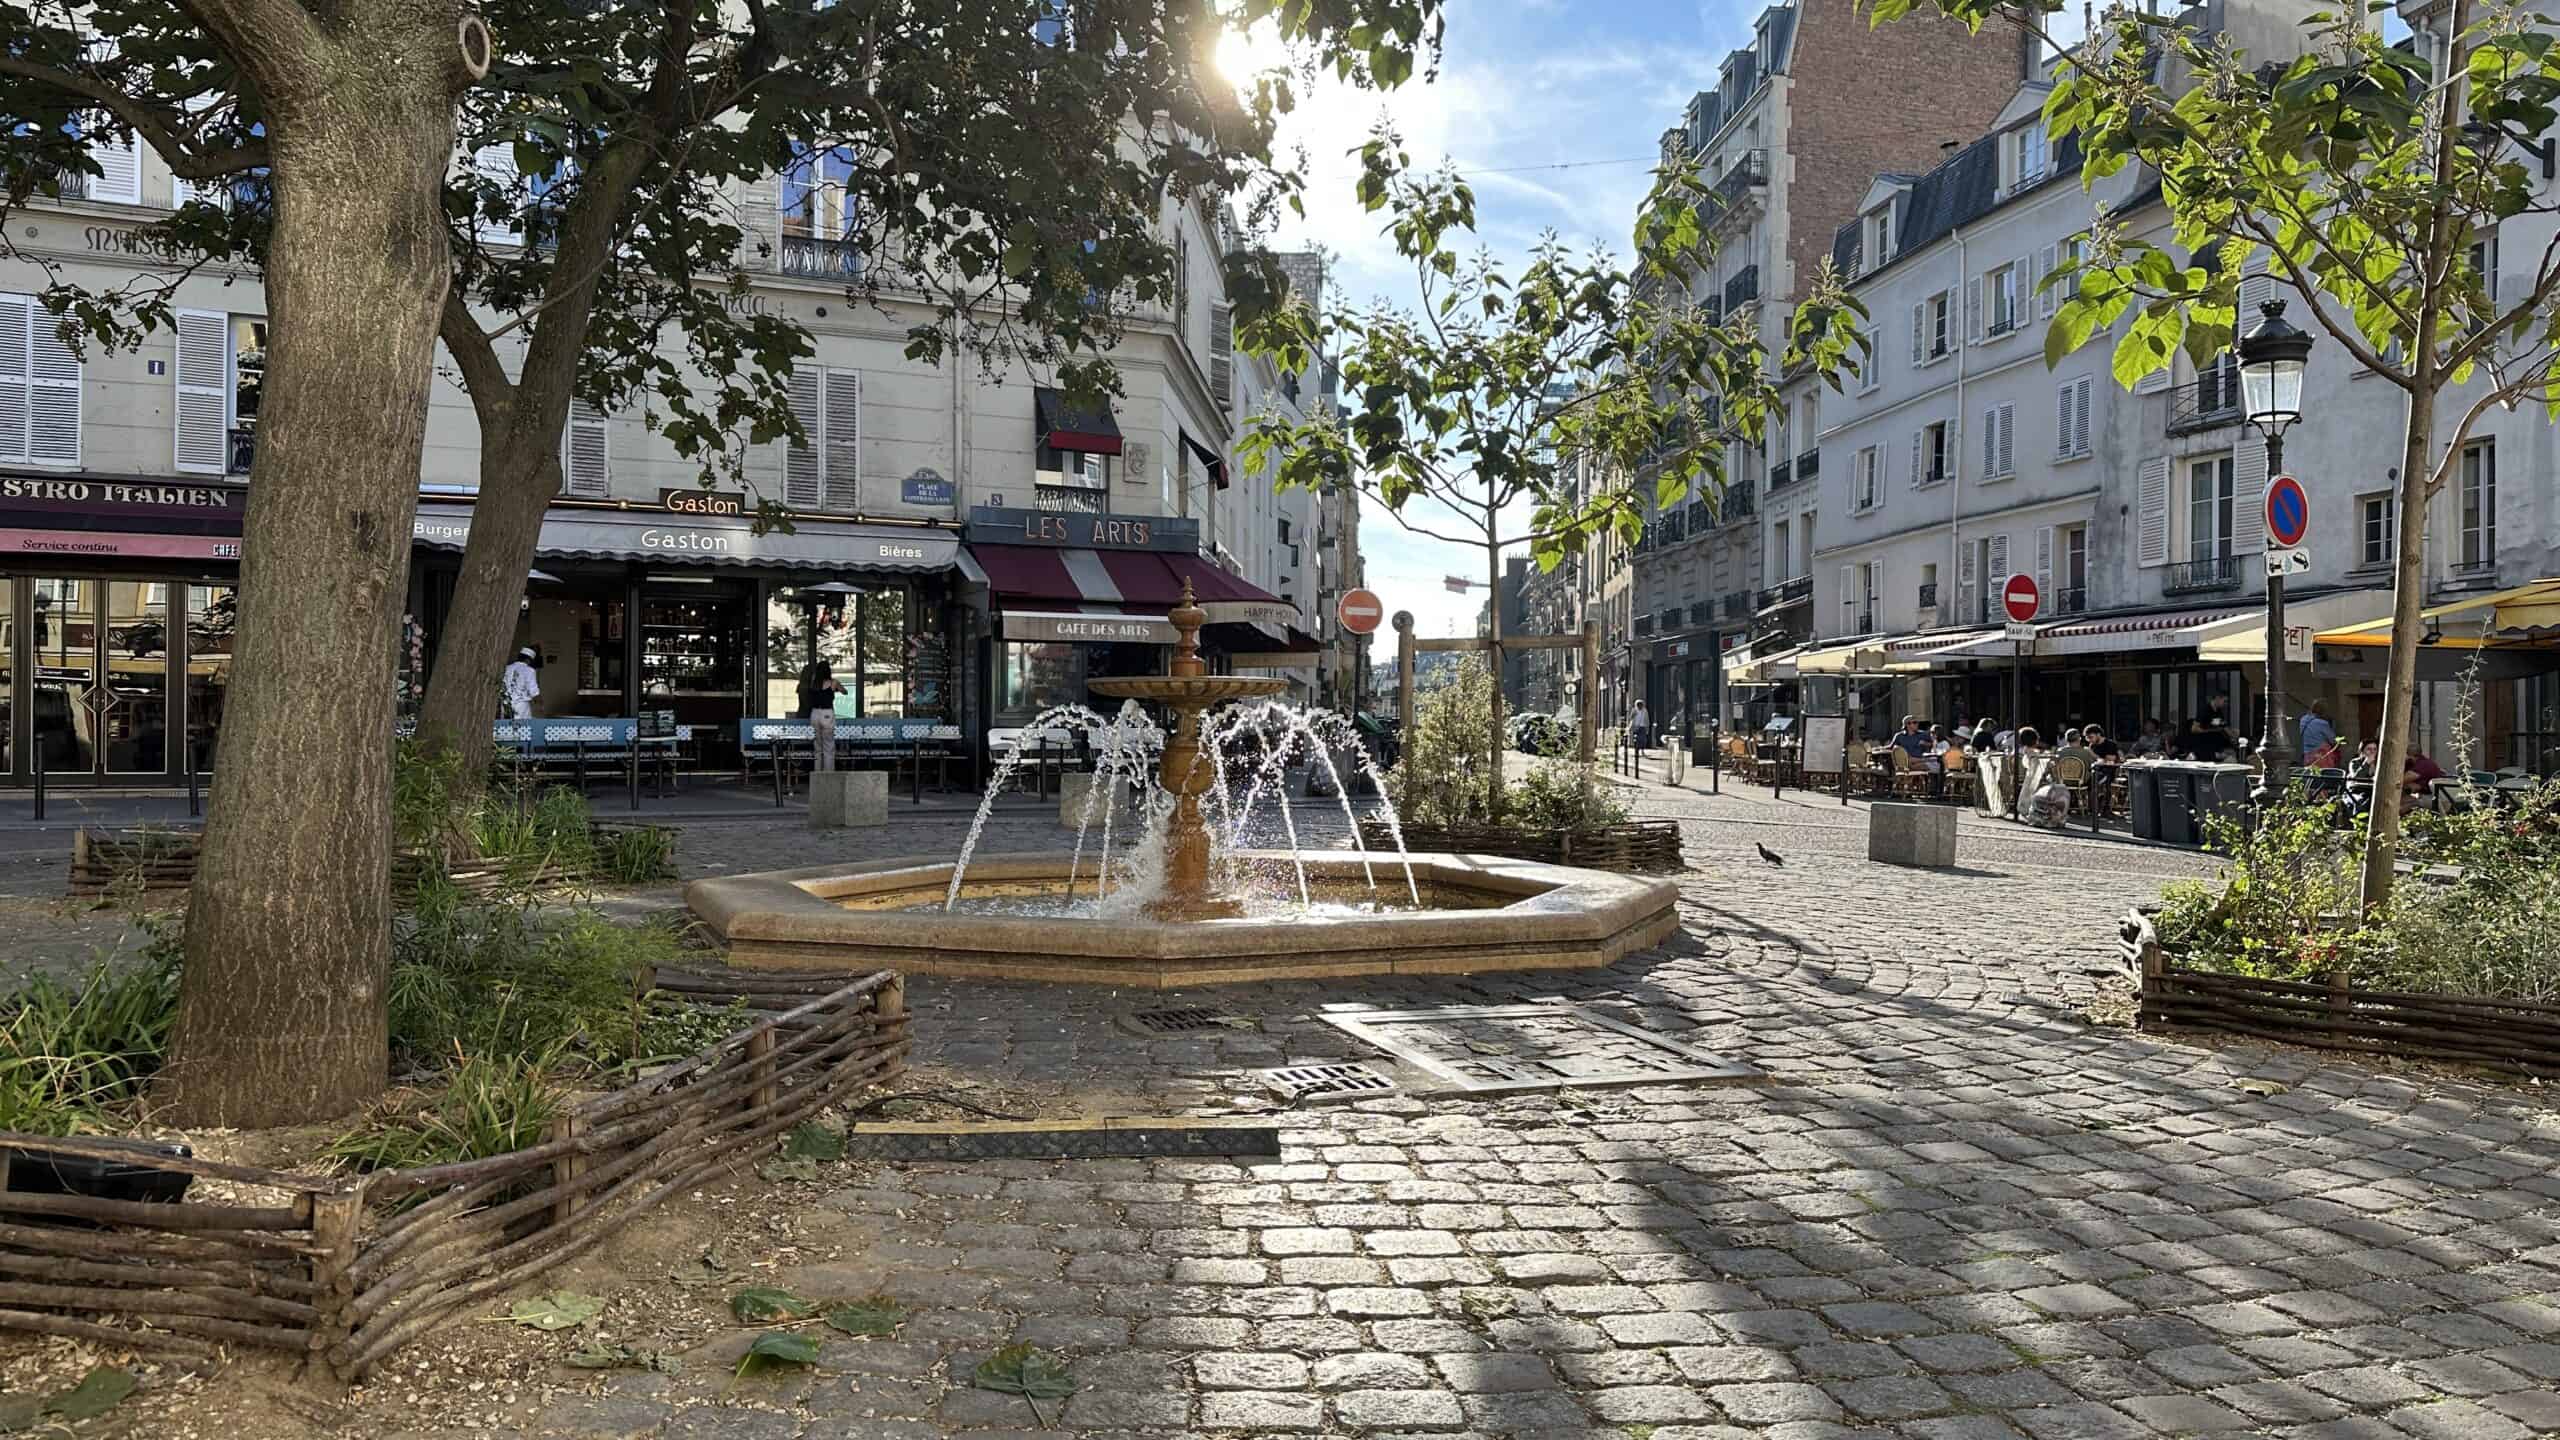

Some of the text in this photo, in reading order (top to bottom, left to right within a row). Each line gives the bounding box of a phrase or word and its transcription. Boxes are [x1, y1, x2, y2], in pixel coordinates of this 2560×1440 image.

[0, 479, 229, 507] STRO ITALIEN
[666, 490, 738, 514] Gaston
[1026, 516, 1149, 544] LES ARTS
[23, 539, 118, 553] Service continu
[641, 530, 728, 551] Gaston
[880, 545, 922, 558] Bières
[1244, 607, 1274, 617] HAPPY
[1091, 624, 1115, 636] DES
[1119, 625, 1151, 637] ARTS
